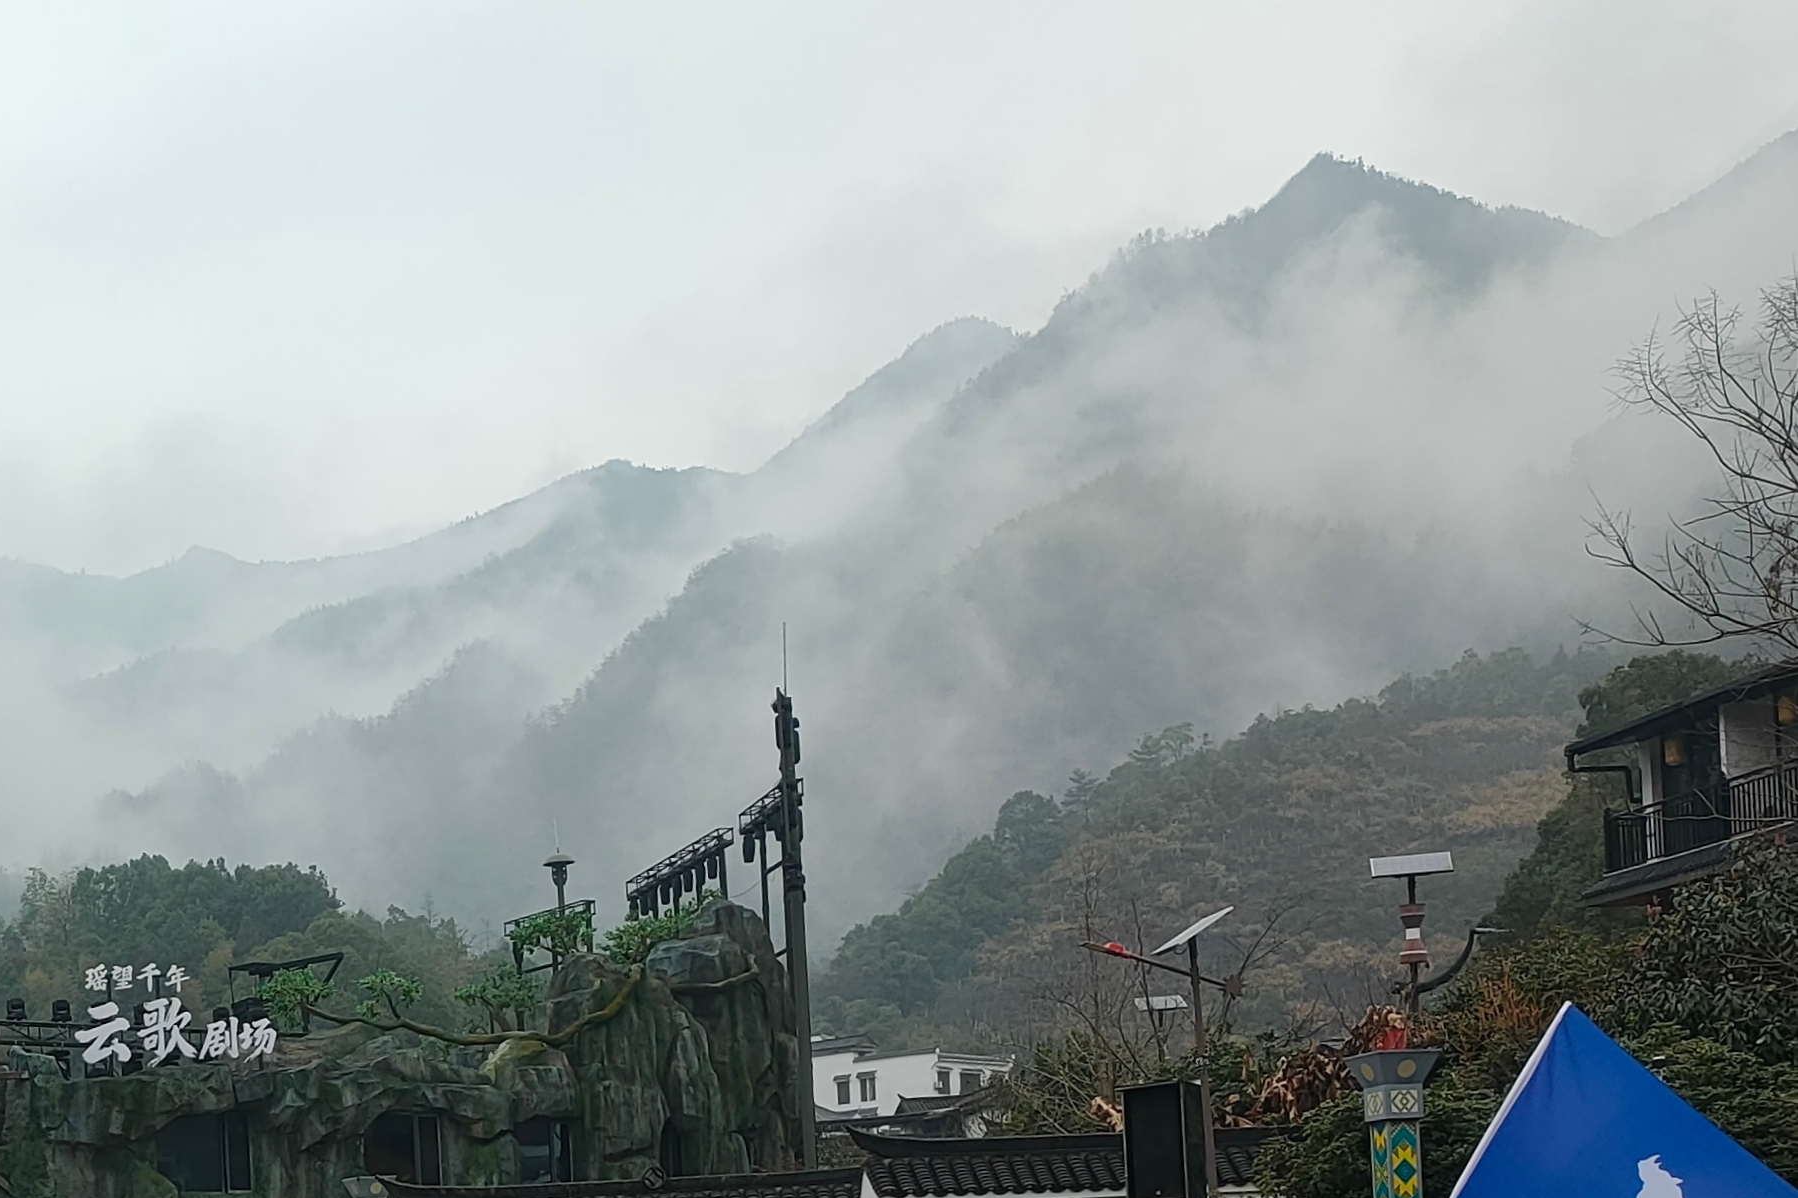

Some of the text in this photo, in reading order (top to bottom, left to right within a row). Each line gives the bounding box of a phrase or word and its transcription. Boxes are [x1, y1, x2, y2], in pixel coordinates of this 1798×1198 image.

[84, 963, 190, 992] 瑶望千年
[74, 997, 277, 1067] 云歌剧场
